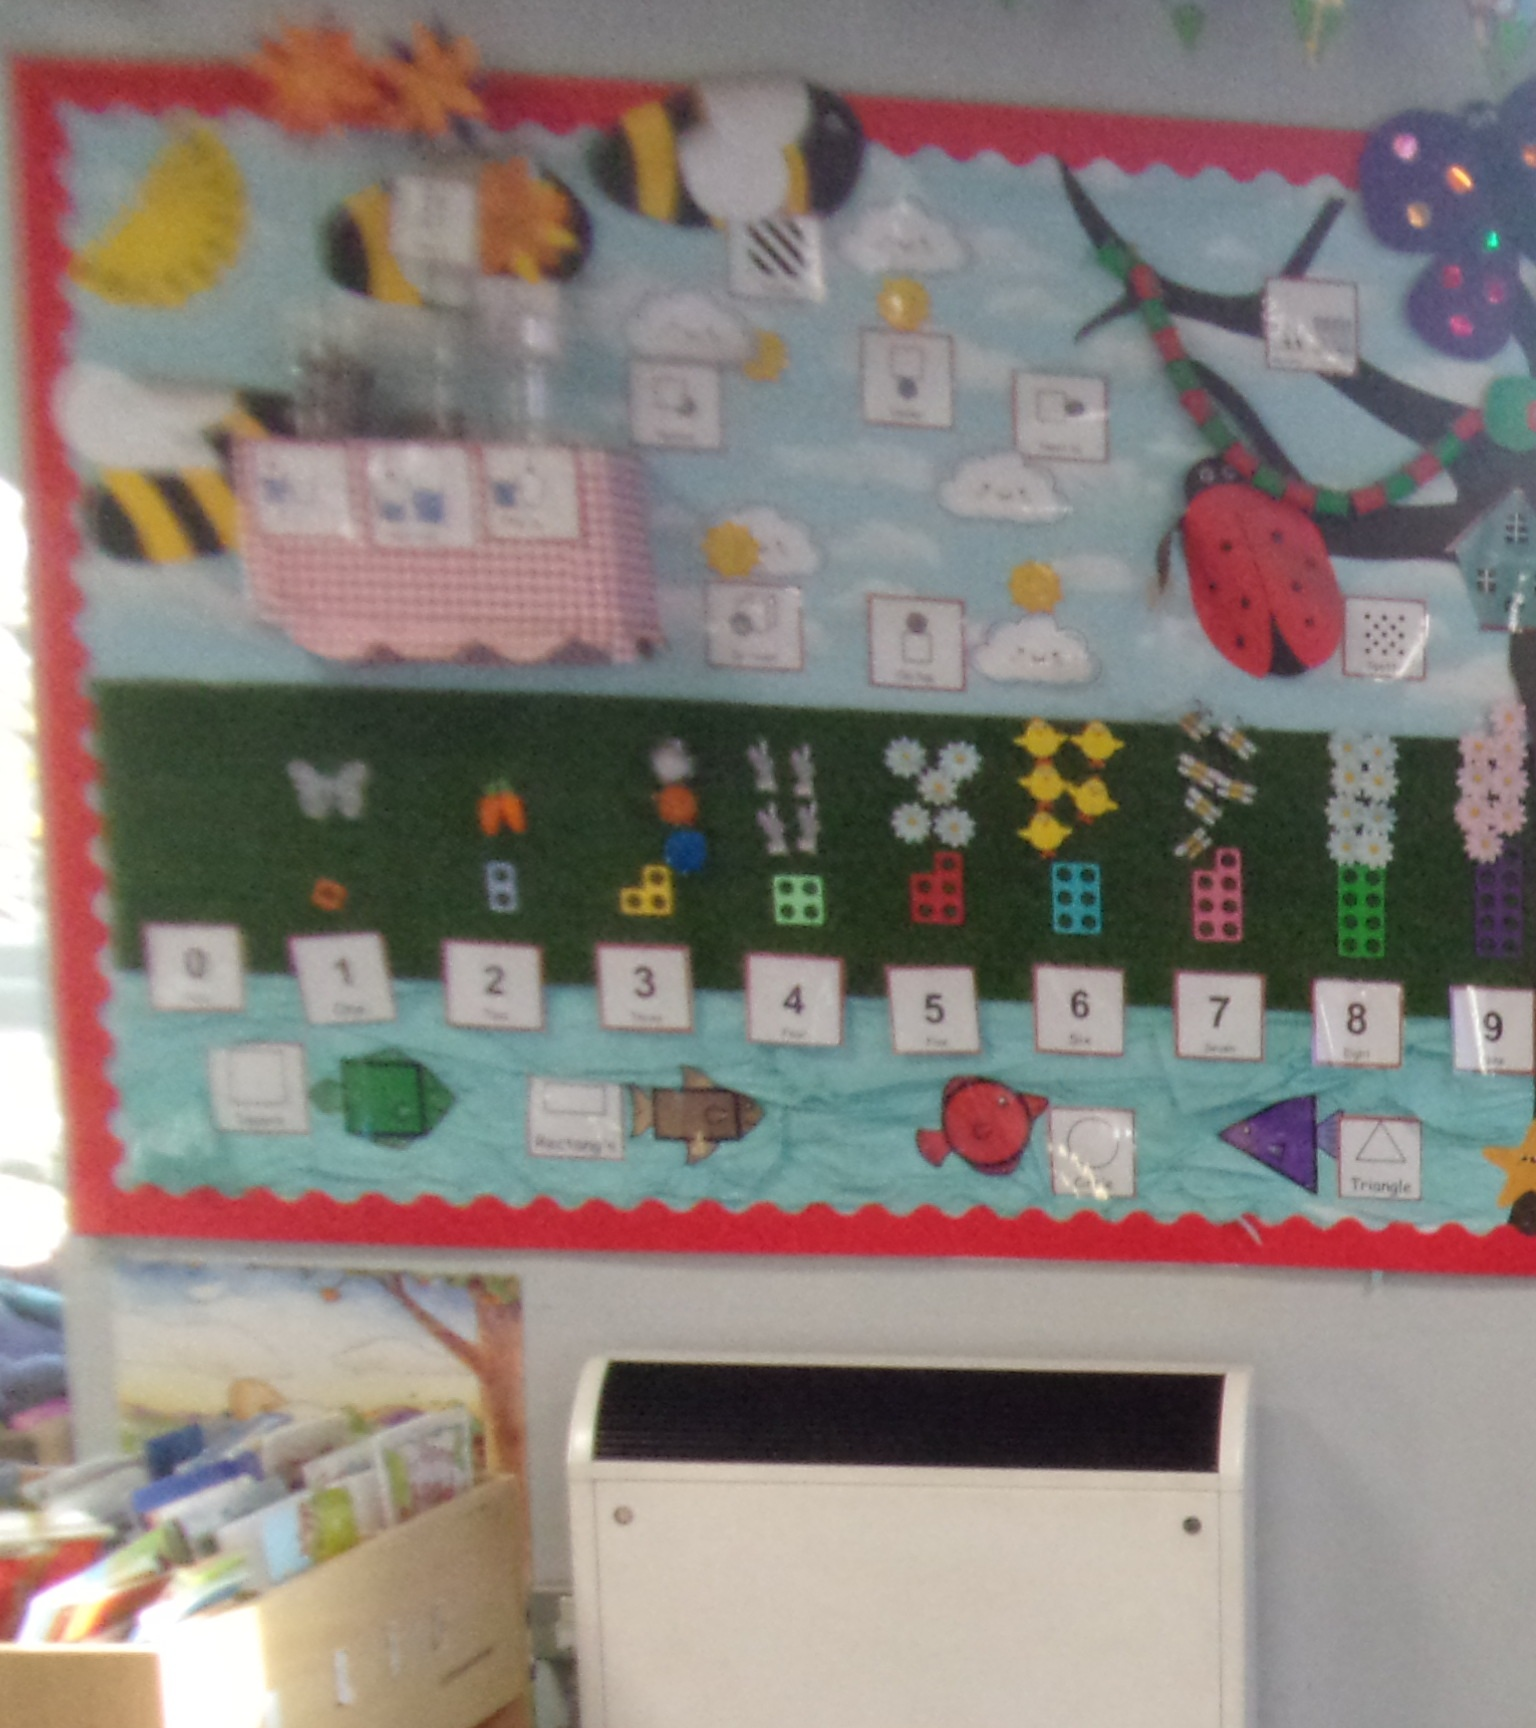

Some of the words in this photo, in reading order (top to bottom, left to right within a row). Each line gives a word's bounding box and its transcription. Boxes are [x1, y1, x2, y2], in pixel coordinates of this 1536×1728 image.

[484, 964, 506, 996] 2
[634, 964, 656, 999] 3
[783, 985, 805, 1014] 4
[924, 993, 946, 1024] 5
[1070, 989, 1090, 1019] 6
[1208, 995, 1231, 1028] 7
[1347, 1002, 1367, 1035] 8
[1483, 1011, 1504, 1042] 9
[1351, 1177, 1412, 1196] Triangle
